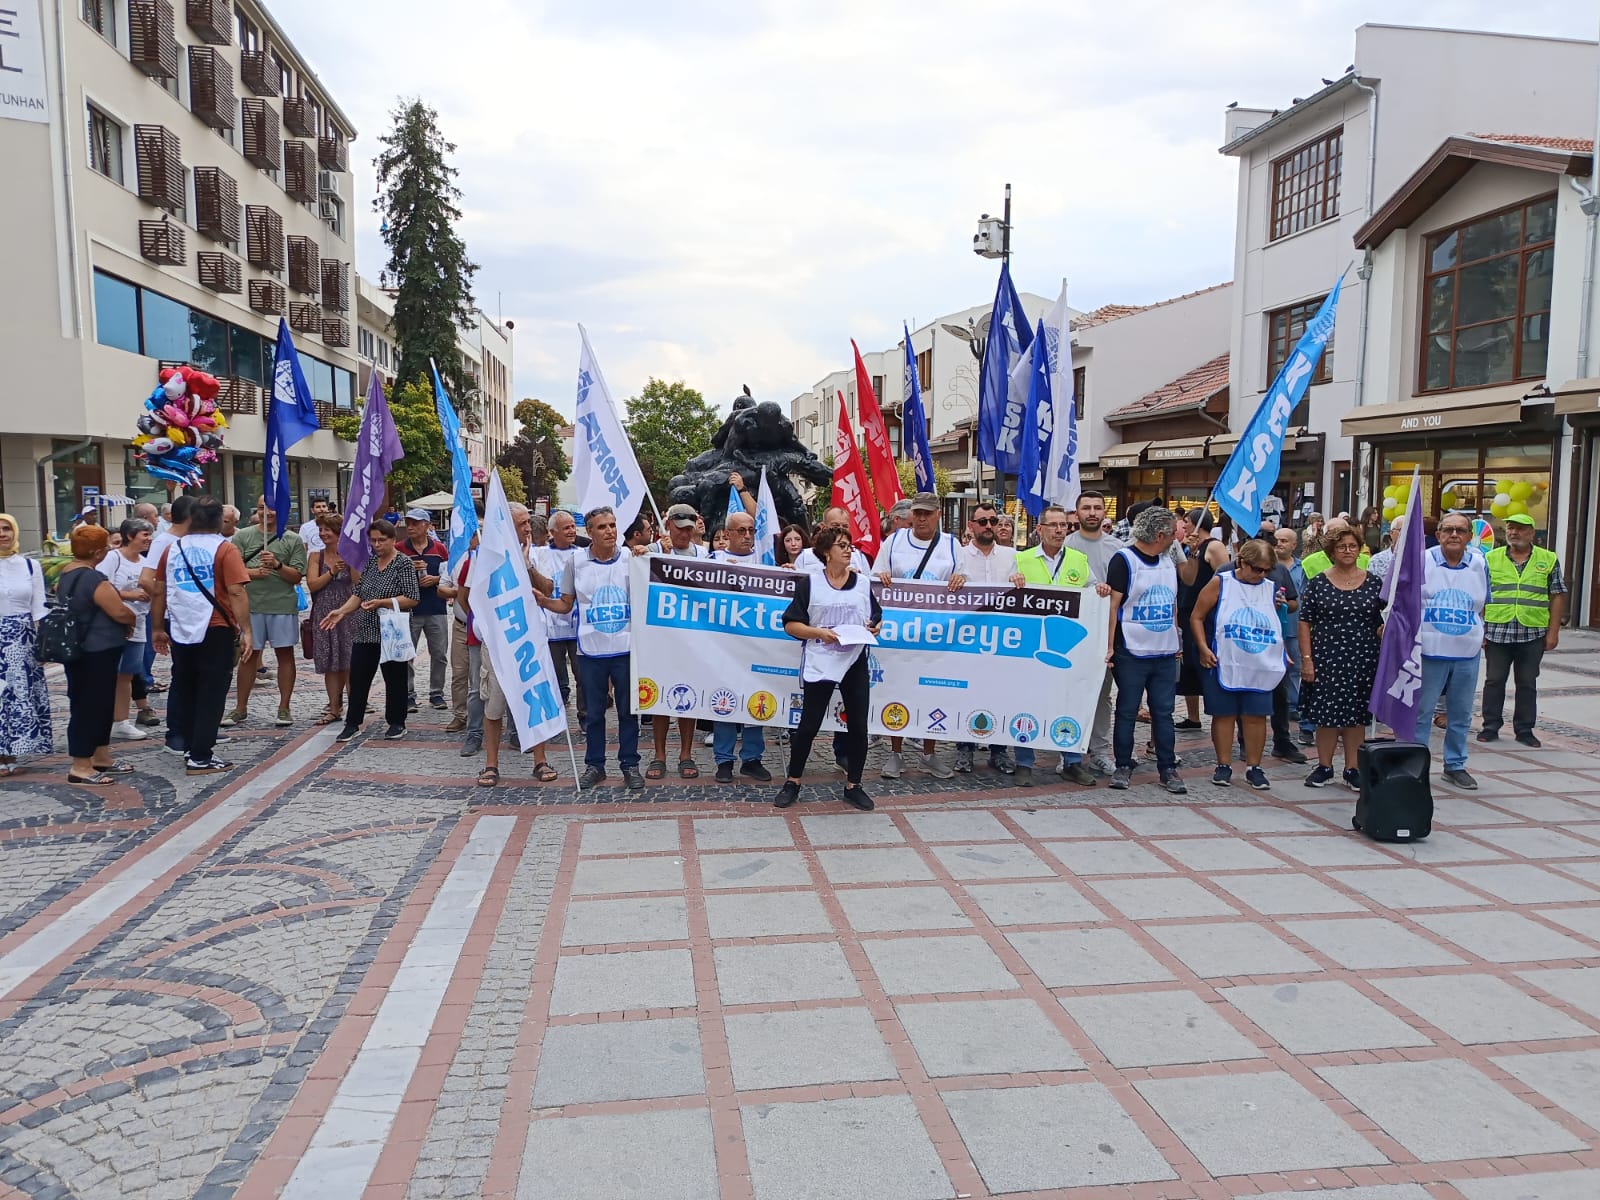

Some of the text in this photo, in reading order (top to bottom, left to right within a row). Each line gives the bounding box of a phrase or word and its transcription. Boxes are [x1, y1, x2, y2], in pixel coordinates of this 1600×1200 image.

[1228, 351, 1313, 513] KESK
[1401, 415, 1441, 429] AND YOU
[662, 564, 796, 594] Yoksullaşmaya
[881, 587, 1016, 610] Güvencesizliğe
[1023, 594, 1070, 615] Karşı
[657, 591, 784, 632] Birlikte
[1132, 604, 1174, 620] KES
[1424, 607, 1477, 625] KESK
[1223, 624, 1277, 644] KESK
